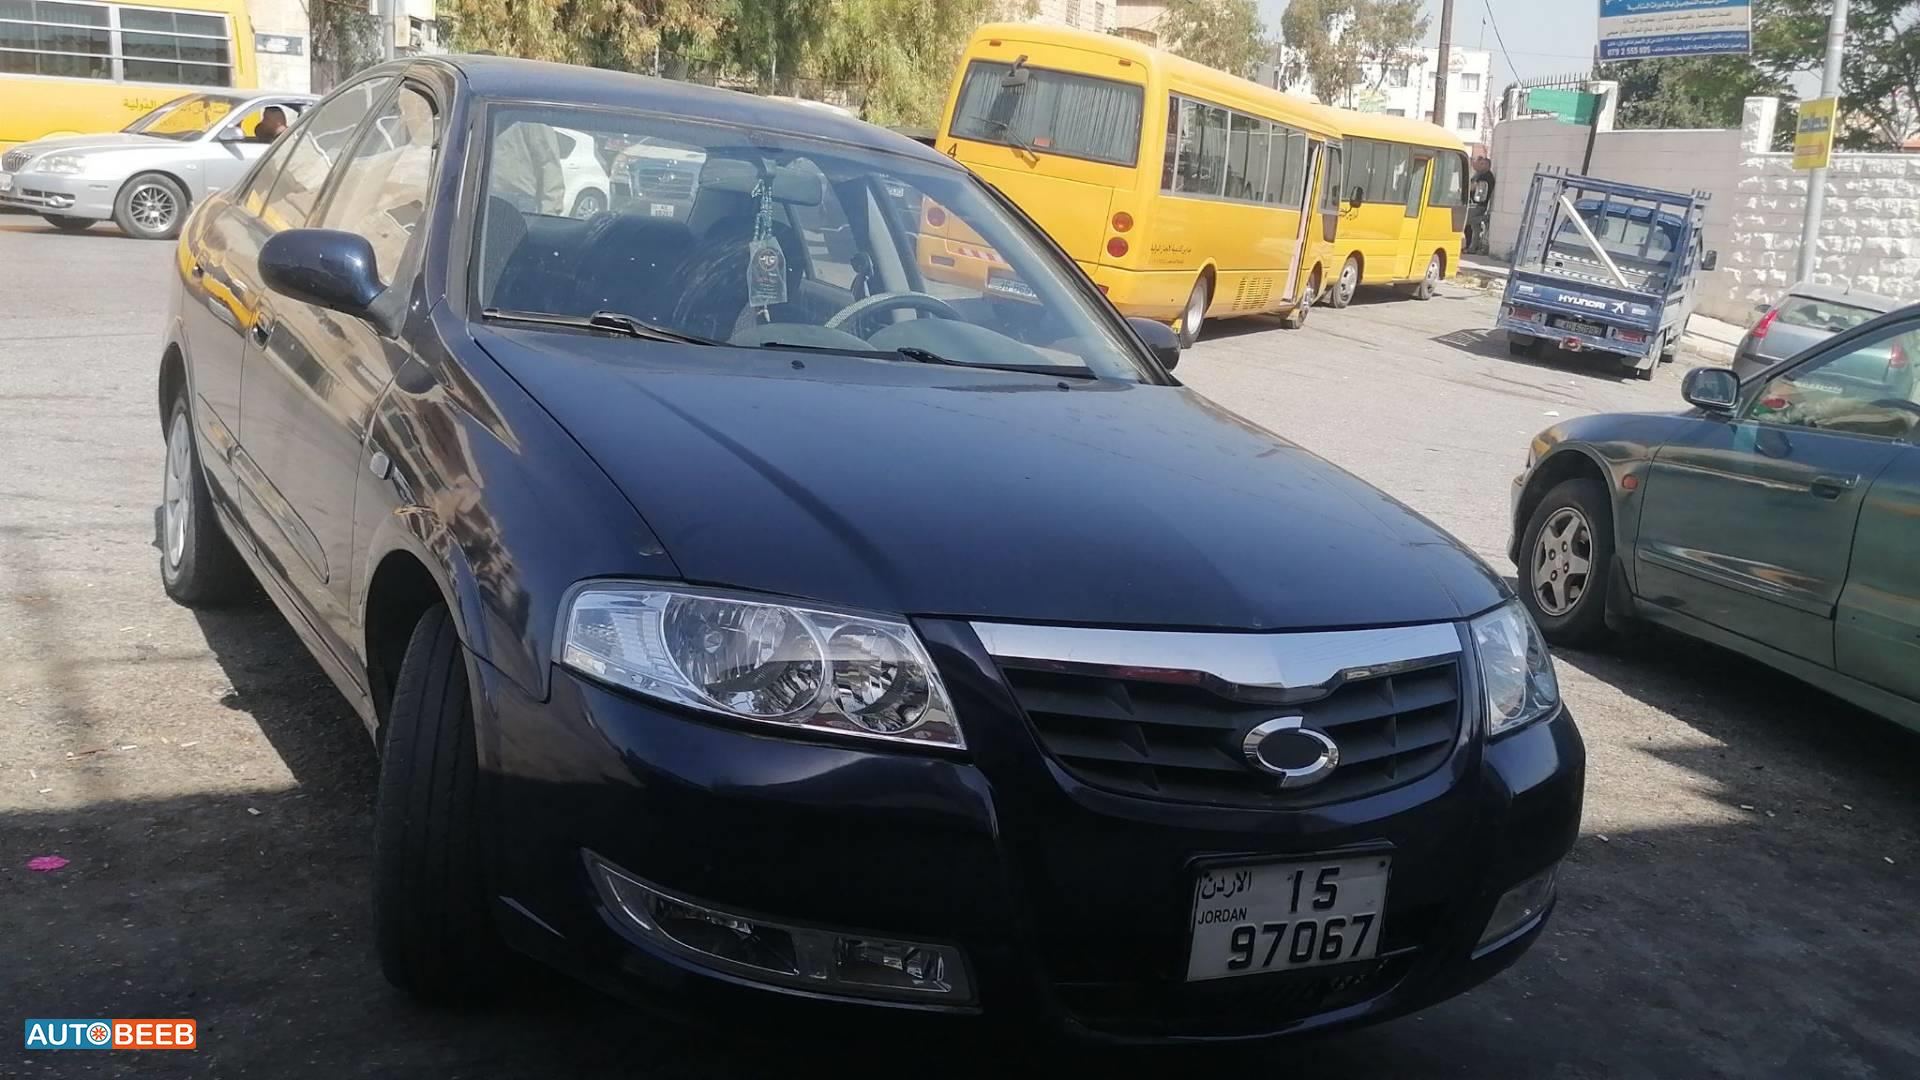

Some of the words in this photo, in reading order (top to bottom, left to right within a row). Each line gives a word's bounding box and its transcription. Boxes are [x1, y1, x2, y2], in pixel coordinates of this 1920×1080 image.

[947, 143, 958, 159] 4
[1558, 294, 1606, 310] HYUNDAI
[1289, 865, 1341, 914] 15
[1198, 907, 1247, 925] JORDAN
[1226, 911, 1377, 970] 97067
